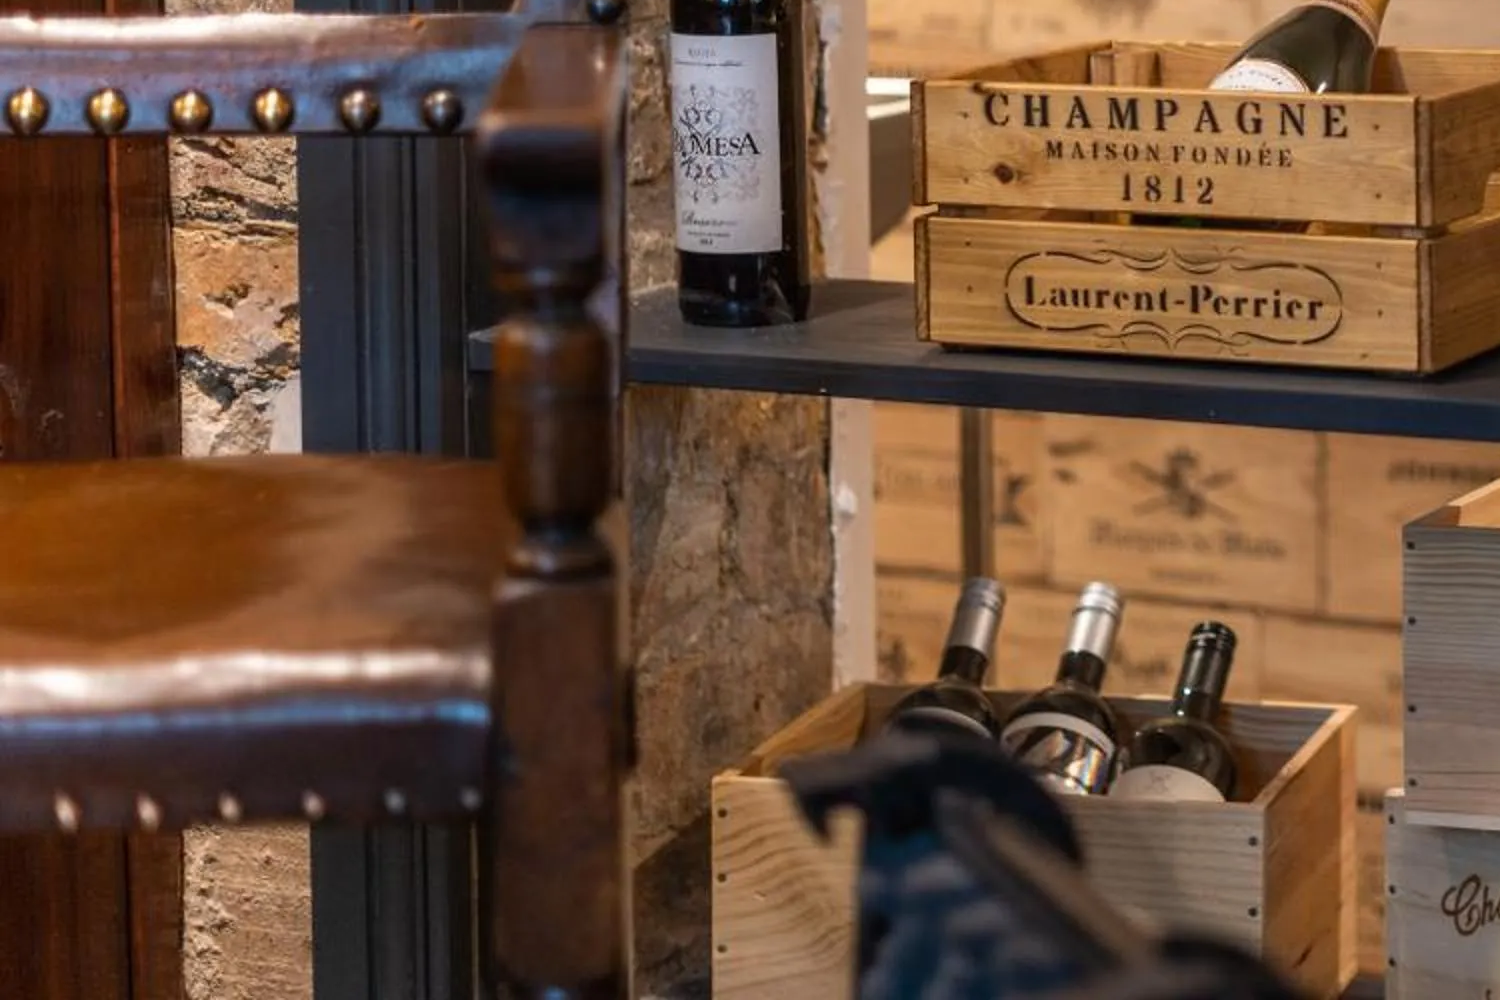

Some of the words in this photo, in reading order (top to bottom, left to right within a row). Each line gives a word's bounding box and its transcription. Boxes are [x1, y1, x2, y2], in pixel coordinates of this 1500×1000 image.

[983, 94, 1349, 139] CHAMPAGNE
[1046, 140, 1161, 165] MAISON
[1172, 142, 1293, 168] FONDÉE
[1121, 172, 1215, 205] 1812
[1024, 274, 1325, 322] Laurent-Perrier
